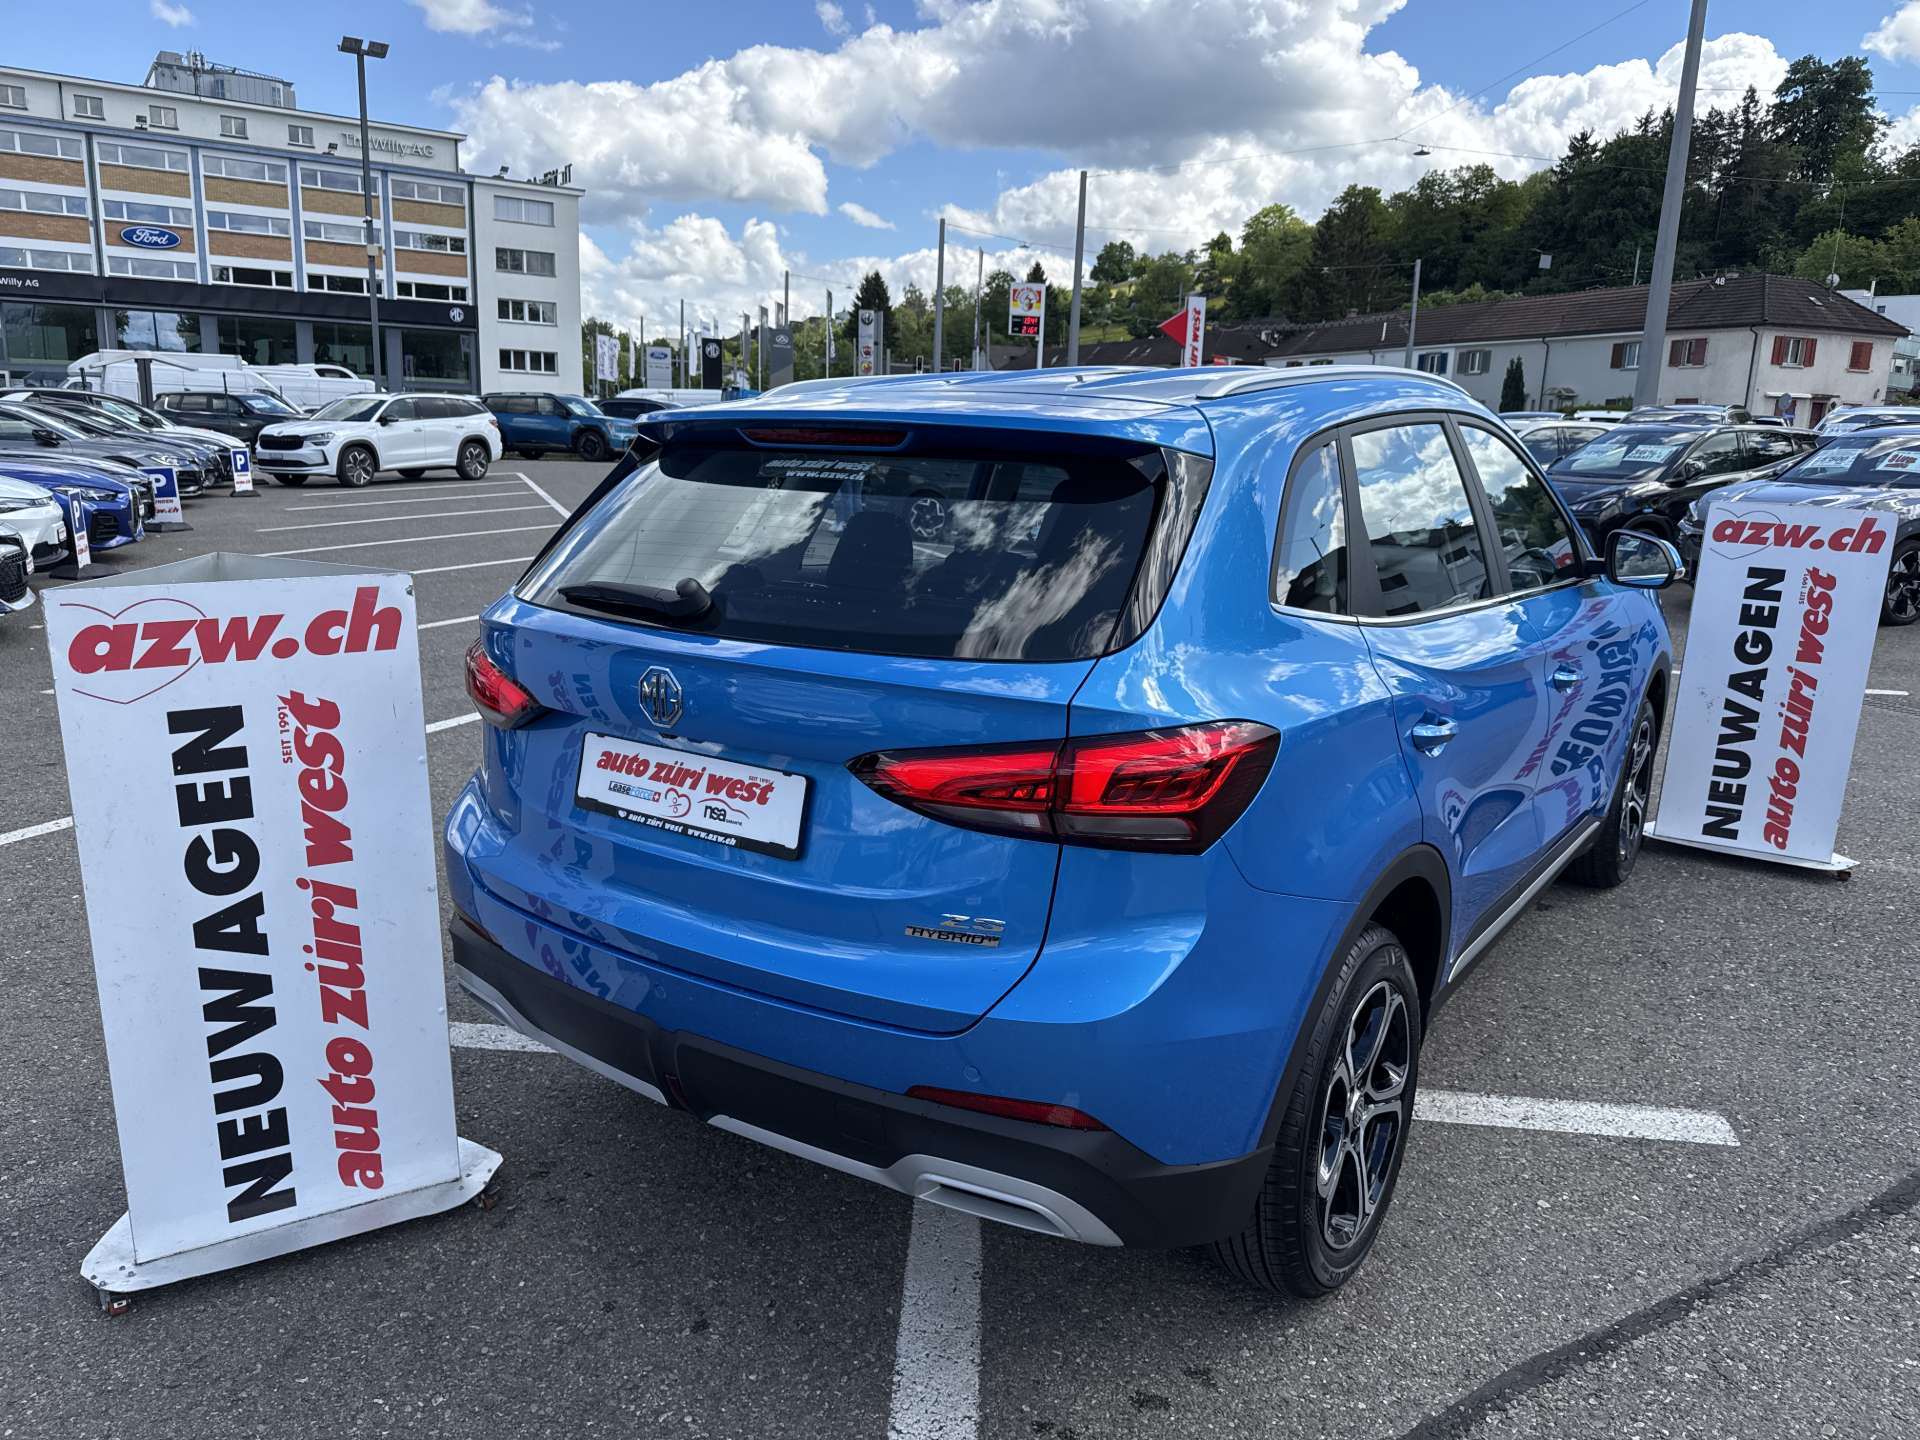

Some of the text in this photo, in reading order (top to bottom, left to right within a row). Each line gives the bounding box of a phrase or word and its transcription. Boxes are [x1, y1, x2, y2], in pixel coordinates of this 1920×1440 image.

[370, 135, 408, 157] Willy
[411, 144, 434, 159] AG
[132, 228, 169, 244] Ford
[0, 277, 39, 288] Willy AG
[236, 454, 245, 470] P
[149, 473, 167, 494] P
[72, 500, 80, 528] P
[1712, 517, 1887, 554] azw.ch
[68, 586, 402, 674] azw.ch
[1702, 566, 1787, 840] NEUWAGEN
[1763, 567, 1837, 850] auto züri west
[278, 706, 293, 764] SEIT 1991
[597, 751, 775, 807] auto züri west
[628, 813, 737, 847] auto züri west www.azw.ch
[704, 805, 727, 822] nsa
[276, 690, 384, 1190] auto züri west
[167, 705, 297, 1223] NEUWAGEN
